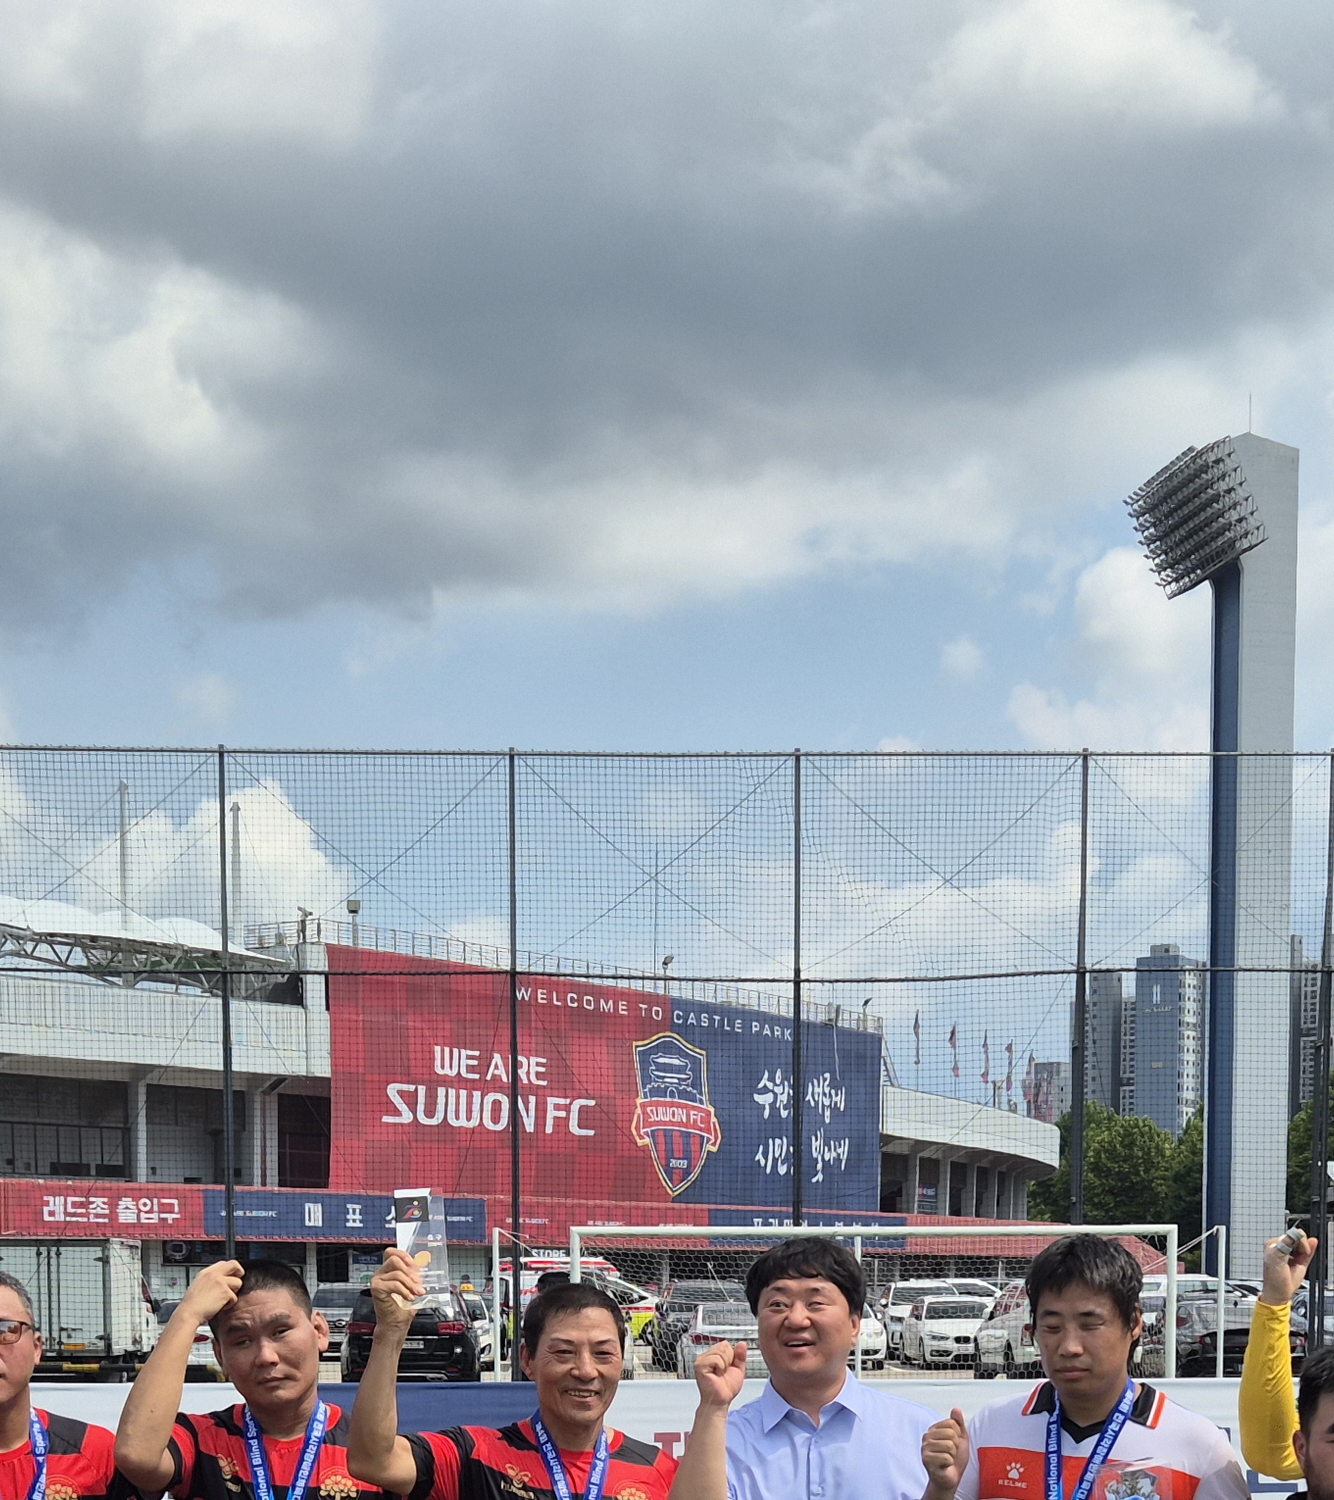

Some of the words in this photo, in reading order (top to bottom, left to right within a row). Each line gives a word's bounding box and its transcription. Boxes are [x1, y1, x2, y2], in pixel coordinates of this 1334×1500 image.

[516, 987, 628, 1015] WELCOME
[639, 1003, 662, 1021] TO
[673, 1010, 742, 1033] CASTLE
[752, 1021, 793, 1042] PARK
[434, 1045, 481, 1080] WE
[485, 1053, 548, 1086] ARE
[381, 1082, 536, 1134] SUWON
[545, 1096, 596, 1136] FC
[753, 1068, 794, 1119] 수원
[647, 1105, 686, 1124] SUWON
[690, 1111, 706, 1128] FC
[754, 1136, 794, 1176] 시민
[42, 1195, 109, 1222] 레드존
[117, 1197, 181, 1224] 출입구
[247, 1439, 262, 1466] Blind
[1048, 1426, 1058, 1452] Blind
[591, 1457, 603, 1483] Blind
[998, 1479, 1028, 1489] KELME
[1047, 1453, 1058, 1500] National
